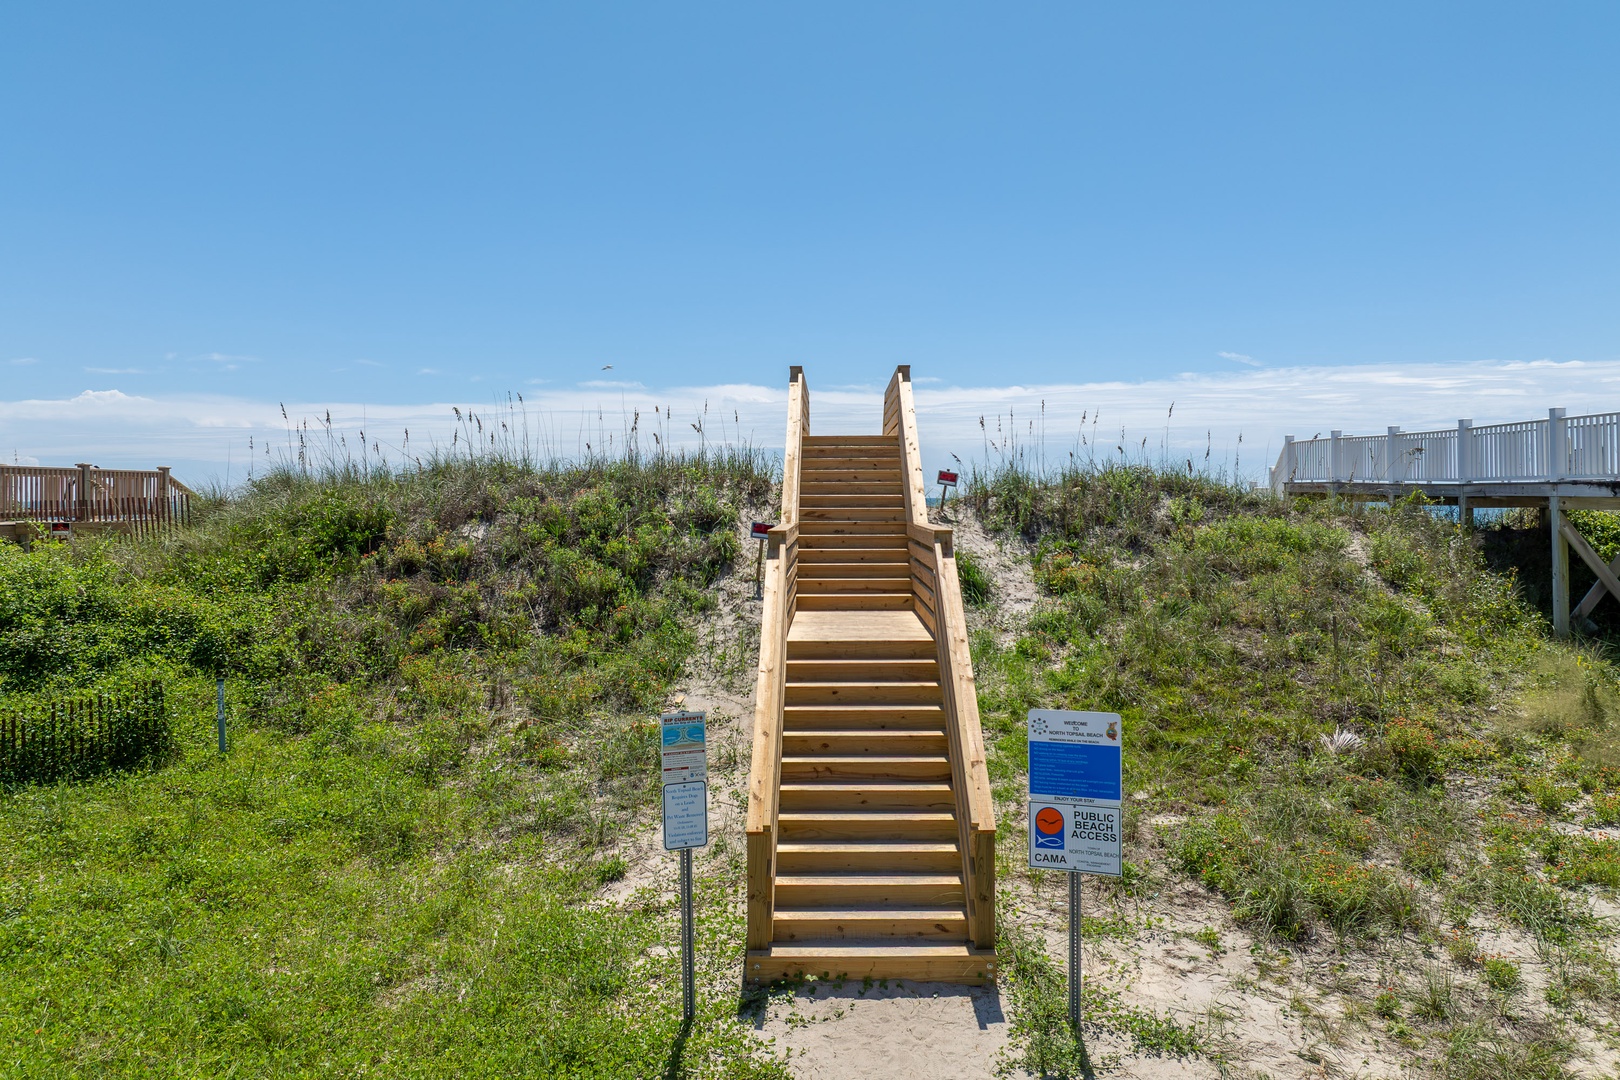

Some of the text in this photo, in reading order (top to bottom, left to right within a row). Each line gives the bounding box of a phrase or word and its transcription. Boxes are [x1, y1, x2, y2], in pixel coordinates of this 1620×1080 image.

[1073, 811, 1114, 822] PUBLIC
[1075, 821, 1113, 832] BEACH
[1071, 830, 1117, 842] ACCESS
[1034, 853, 1067, 864] CAMA
